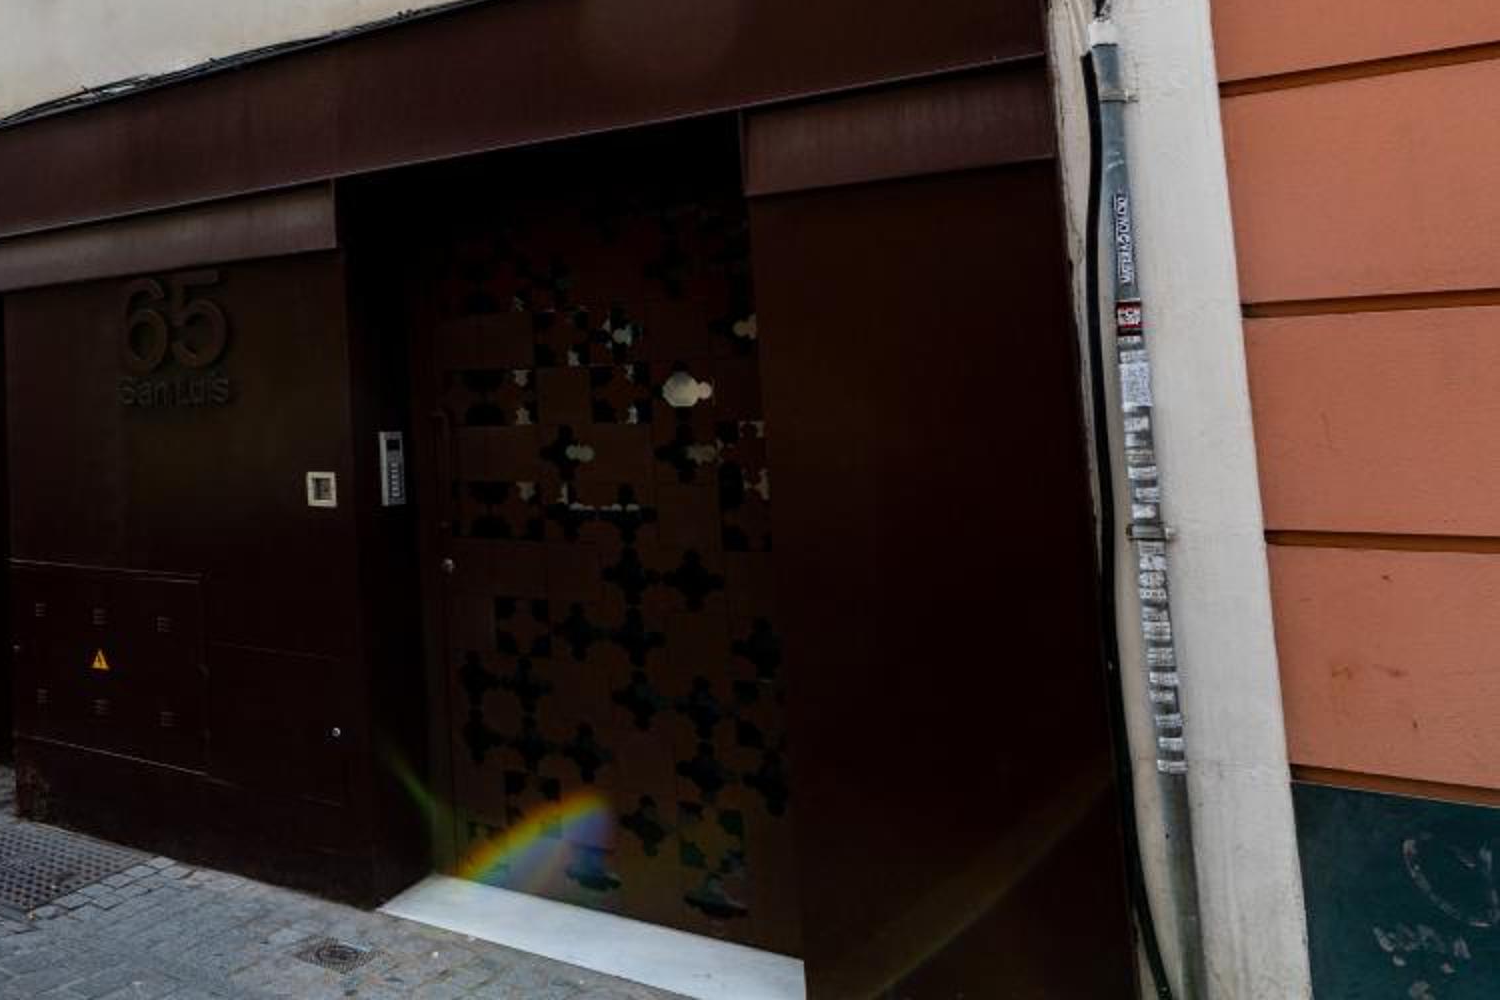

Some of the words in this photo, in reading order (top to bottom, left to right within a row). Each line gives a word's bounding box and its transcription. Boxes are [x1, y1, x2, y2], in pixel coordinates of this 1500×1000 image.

[119, 269, 229, 374] 65
[116, 376, 169, 408] San
[176, 373, 229, 408] Luis
